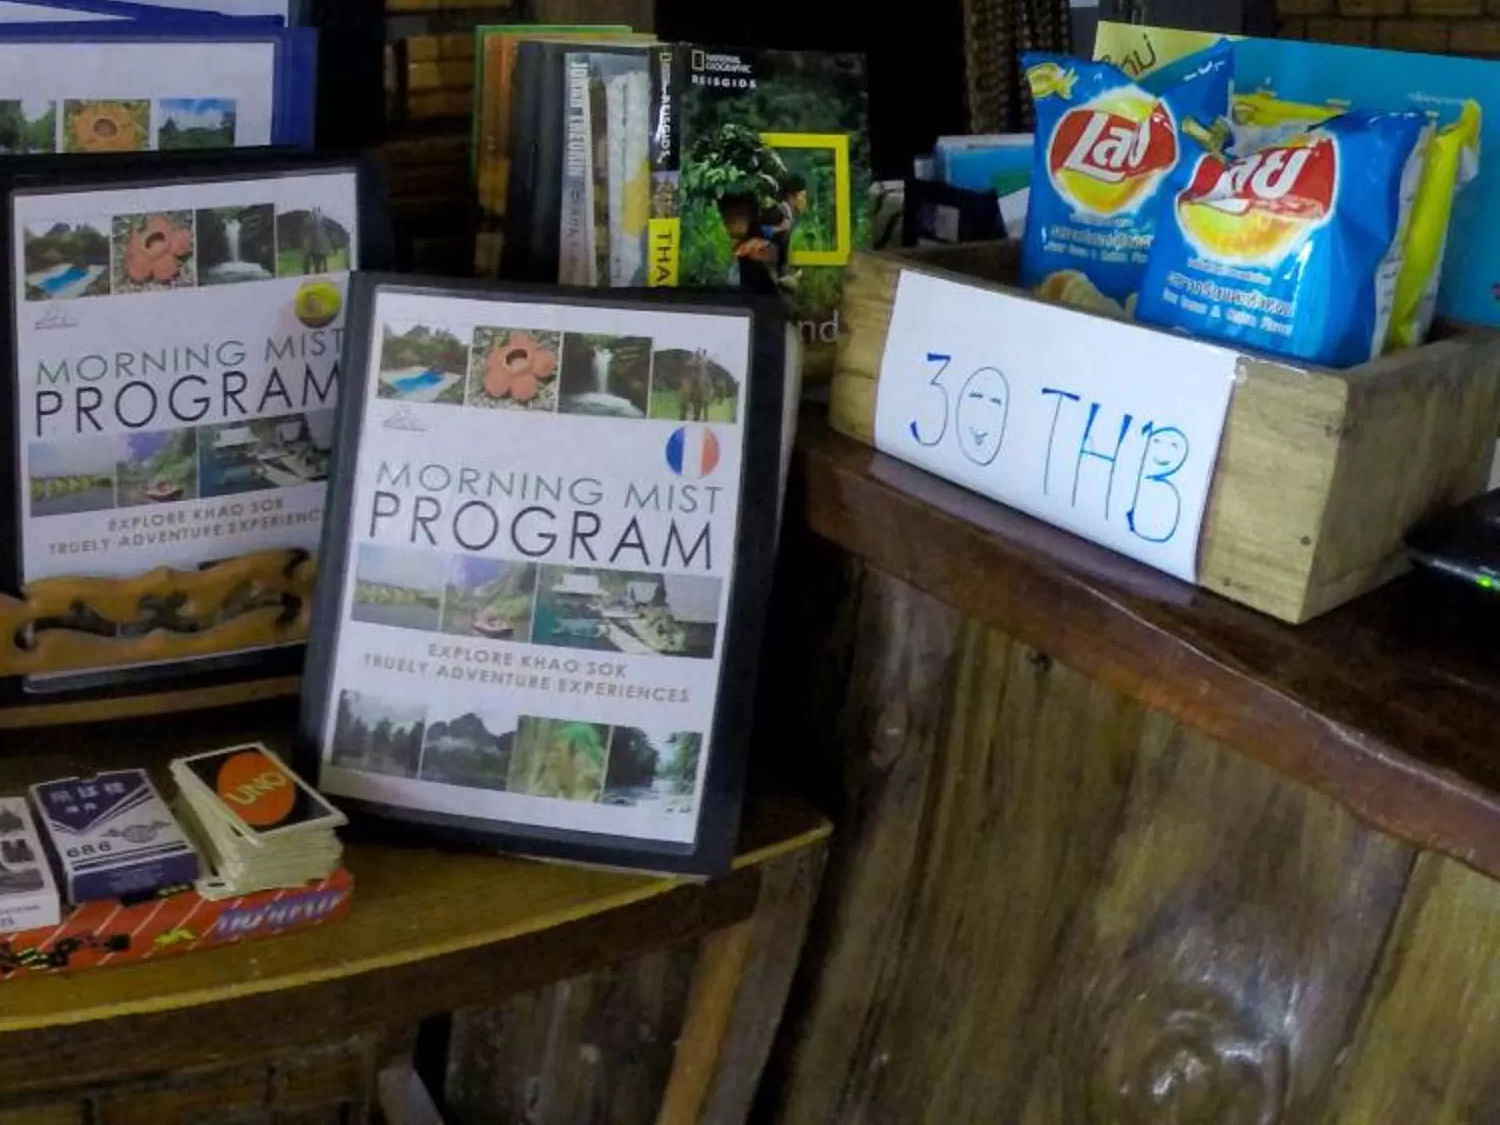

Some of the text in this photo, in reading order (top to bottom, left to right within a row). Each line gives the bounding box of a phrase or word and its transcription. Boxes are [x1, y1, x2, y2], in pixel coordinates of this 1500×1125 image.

[691, 74, 758, 89] REISGIDS
[36, 328, 346, 386] MORNING MIST
[34, 361, 340, 438] PROGRAM
[910, 351, 1191, 544] 30 THB
[374, 459, 724, 515] MORNING MIST
[367, 491, 713, 571] PROGRAM
[427, 642, 629, 680] EXPLORE KHAO SOK
[436, 663, 550, 691] ADVENTURE
[556, 678, 691, 704] EXPERIENCES
[224, 771, 287, 805] UNO
